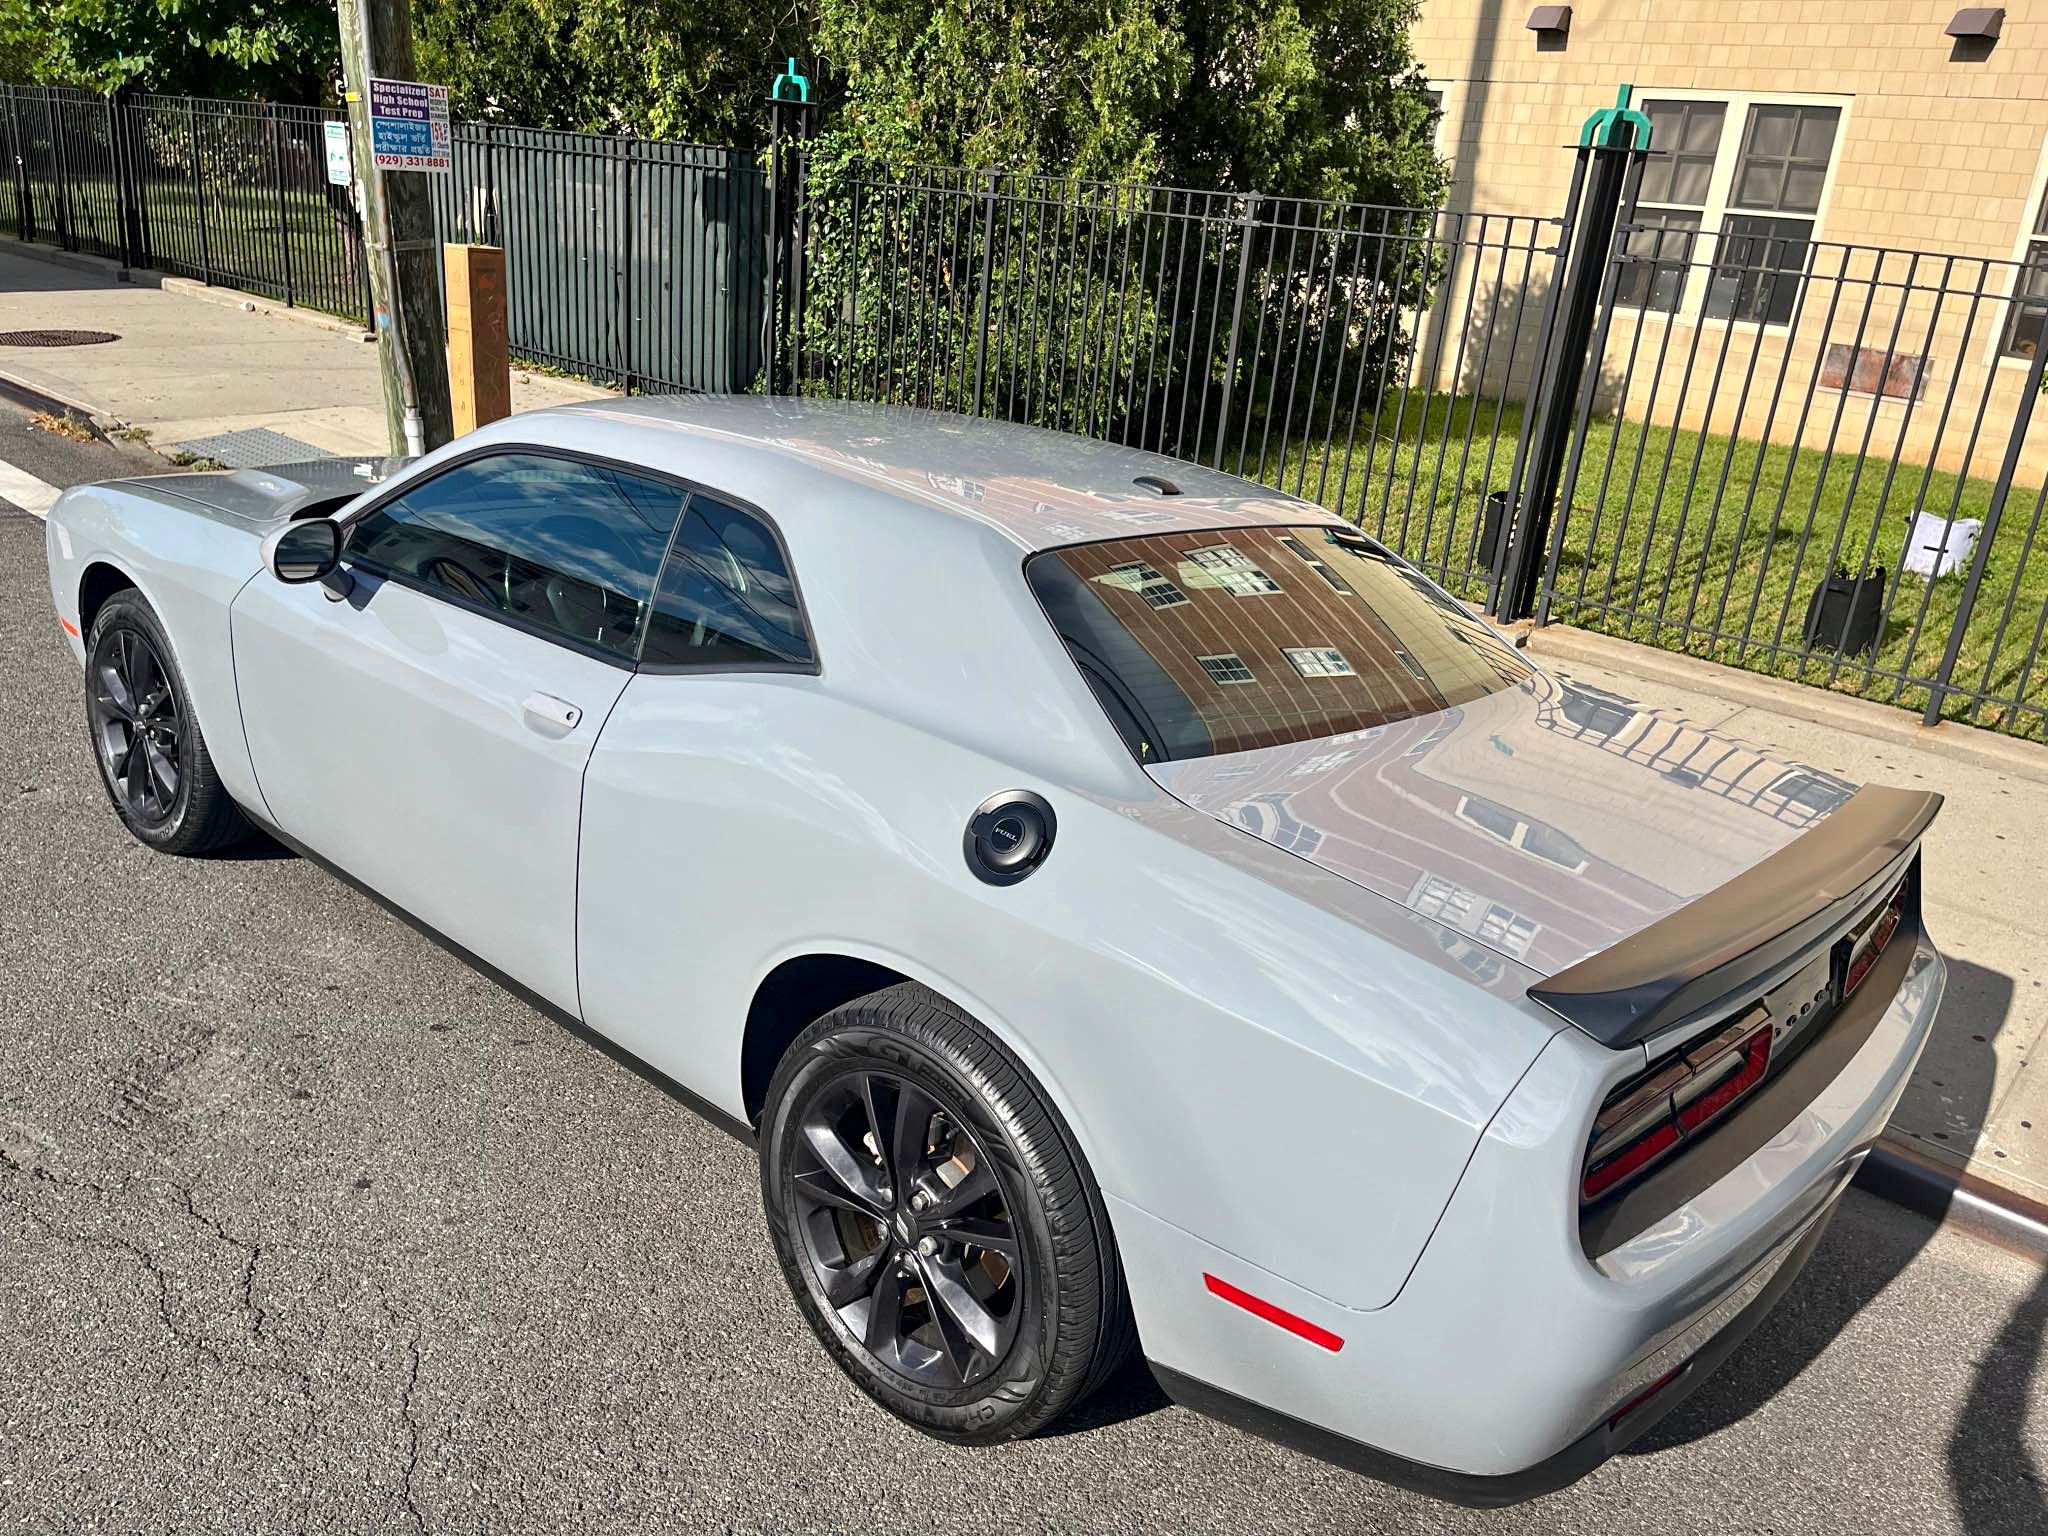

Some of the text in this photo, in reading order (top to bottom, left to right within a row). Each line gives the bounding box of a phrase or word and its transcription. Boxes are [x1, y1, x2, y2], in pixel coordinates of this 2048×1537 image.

[373, 83, 427, 96] Specialized
[429, 88, 446, 98] SAT
[373, 94, 428, 107] High School
[380, 106, 423, 118] Test Prep
[375, 155, 403, 167] (929)
[995, 827, 1017, 842] FUEL
